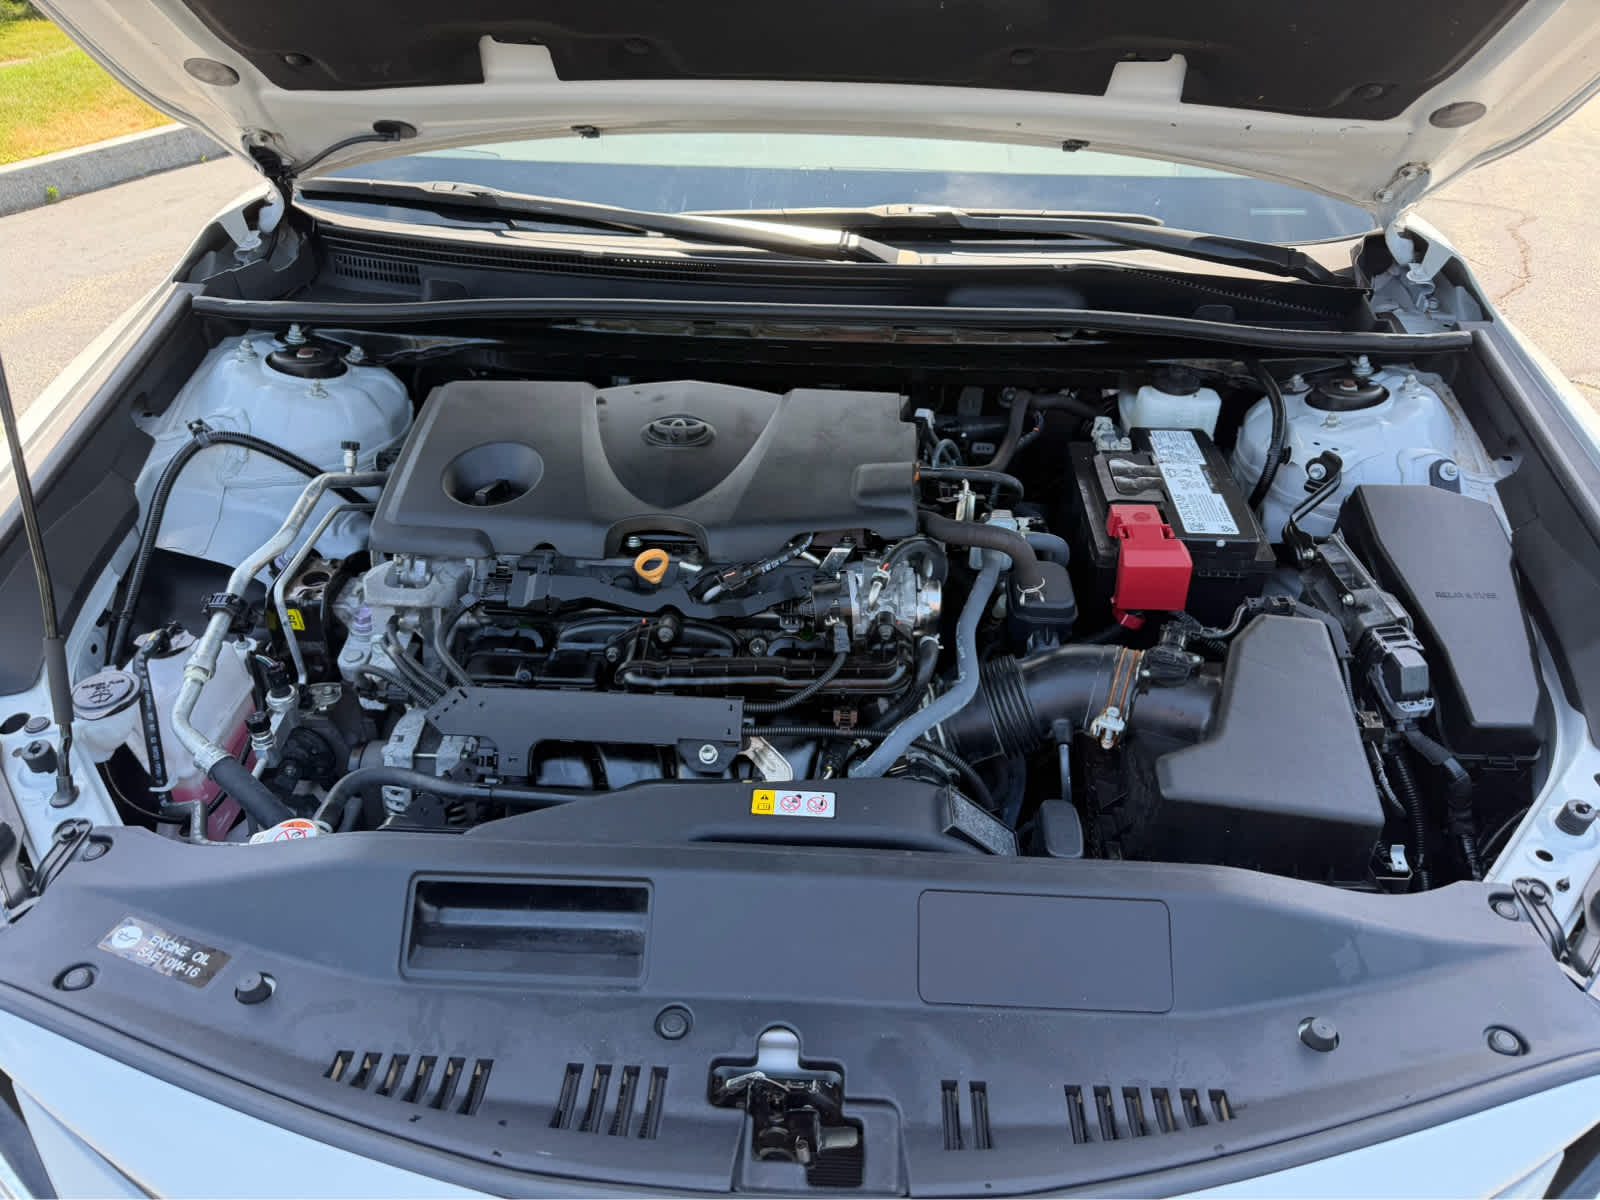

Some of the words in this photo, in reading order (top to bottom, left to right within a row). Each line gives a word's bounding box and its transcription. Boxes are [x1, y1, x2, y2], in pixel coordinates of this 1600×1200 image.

[137, 946, 161, 962] SAE
[150, 935, 190, 956] ENGINE
[192, 951, 210, 966] OIL
